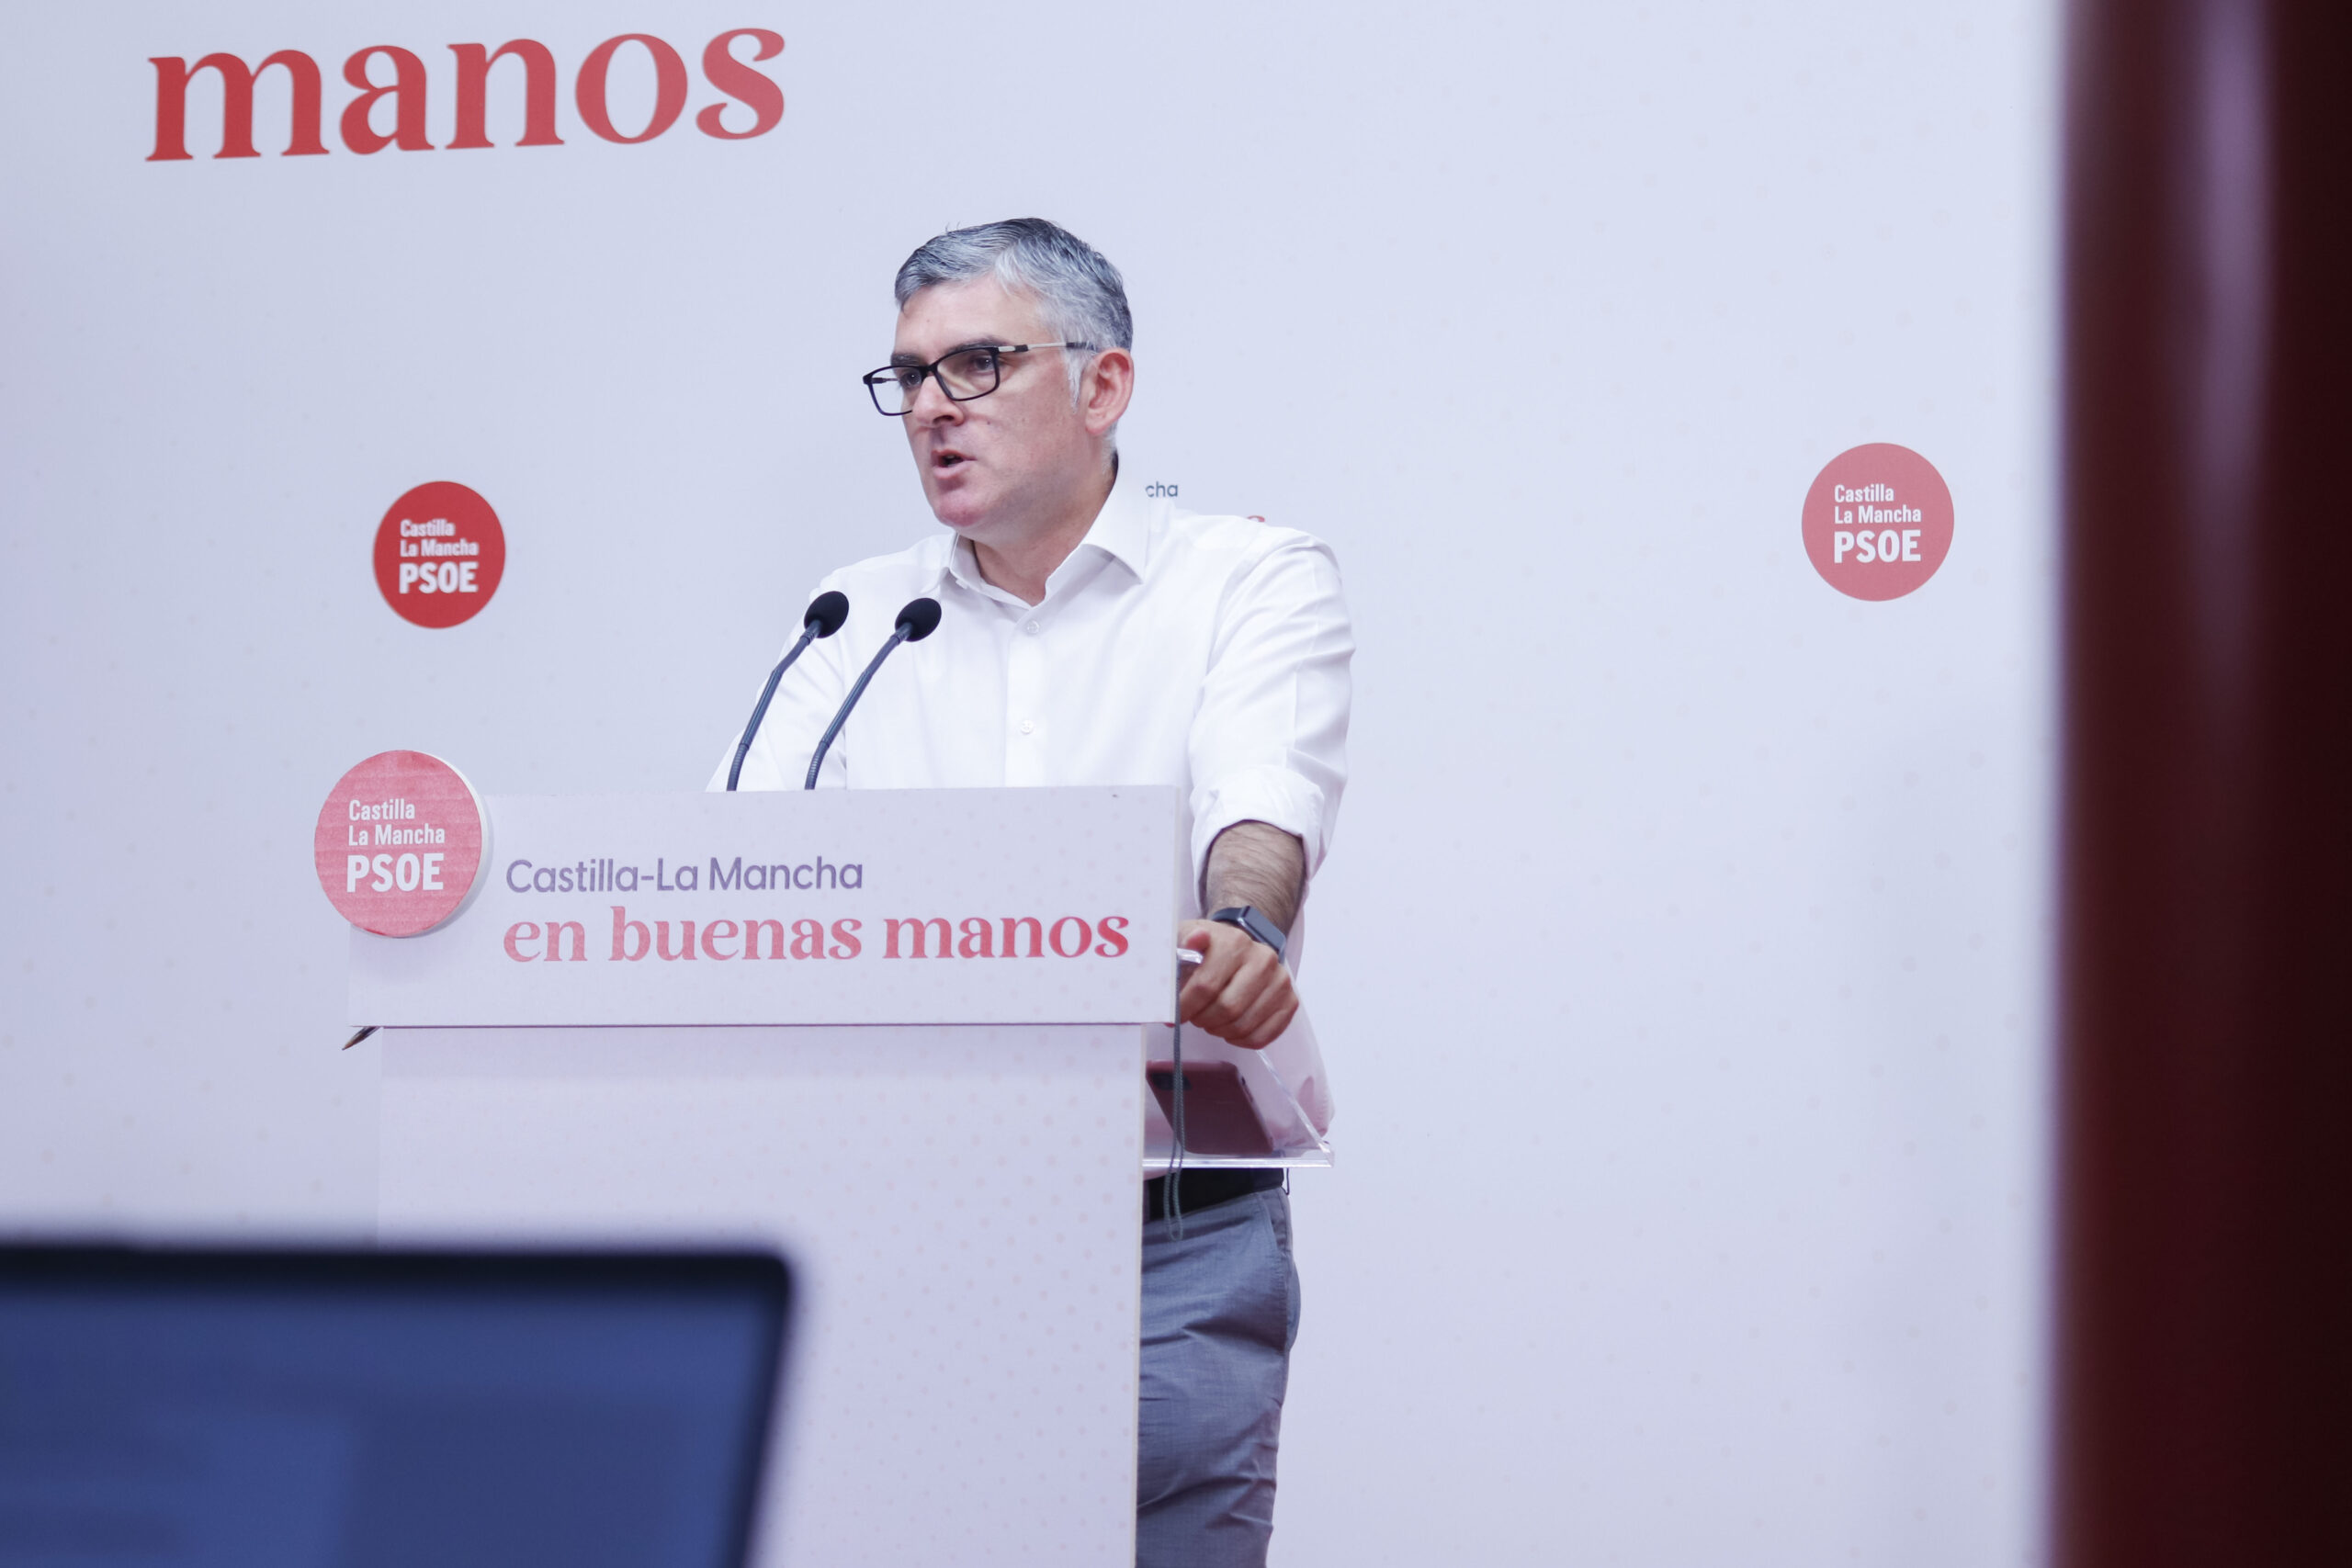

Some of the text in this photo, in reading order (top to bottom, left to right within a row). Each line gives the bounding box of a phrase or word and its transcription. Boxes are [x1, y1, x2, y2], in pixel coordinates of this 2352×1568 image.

[146, 28, 785, 161] manos
[1834, 483, 1894, 502] Castilla
[400, 518, 456, 537] Castilla
[1834, 504, 1922, 525] La Mancha
[400, 537, 480, 558] La Mancha
[1834, 529, 1922, 564] PSOE
[399, 561, 479, 594] PSOE
[348, 798, 416, 821] Castilla
[348, 823, 446, 846] La Mancha
[346, 852, 445, 893] PSOE
[505, 856, 863, 894] Castilla-La Mancha
[503, 906, 1129, 963] en buenas manos
